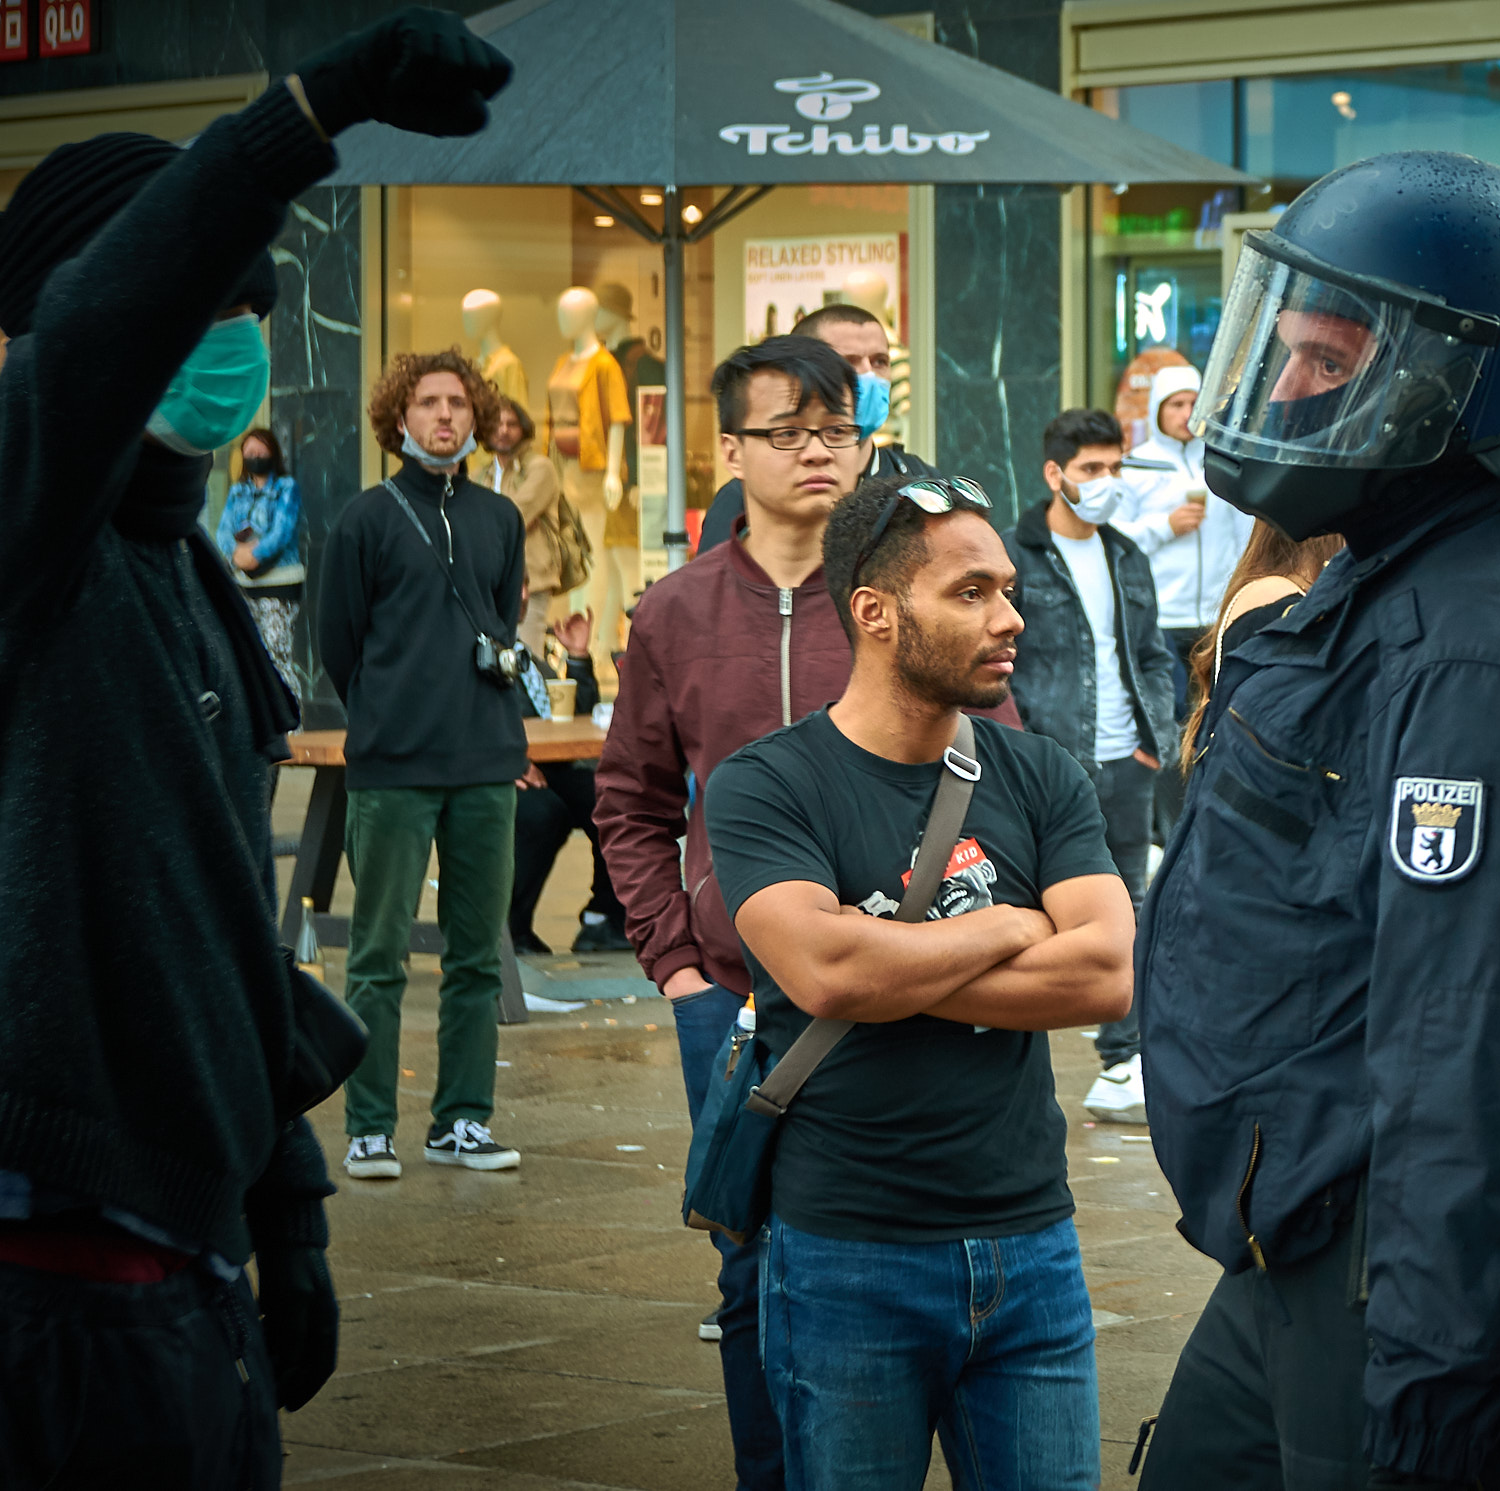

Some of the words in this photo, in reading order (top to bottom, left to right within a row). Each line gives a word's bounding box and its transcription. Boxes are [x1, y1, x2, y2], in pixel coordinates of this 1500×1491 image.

[45, 2, 84, 49] QLO
[719, 124, 990, 155] Tchibo
[748, 244, 822, 268] RELAXED
[825, 240, 896, 265] STYLING
[1400, 782, 1476, 806] POLIZEI
[955, 846, 978, 865] KID
